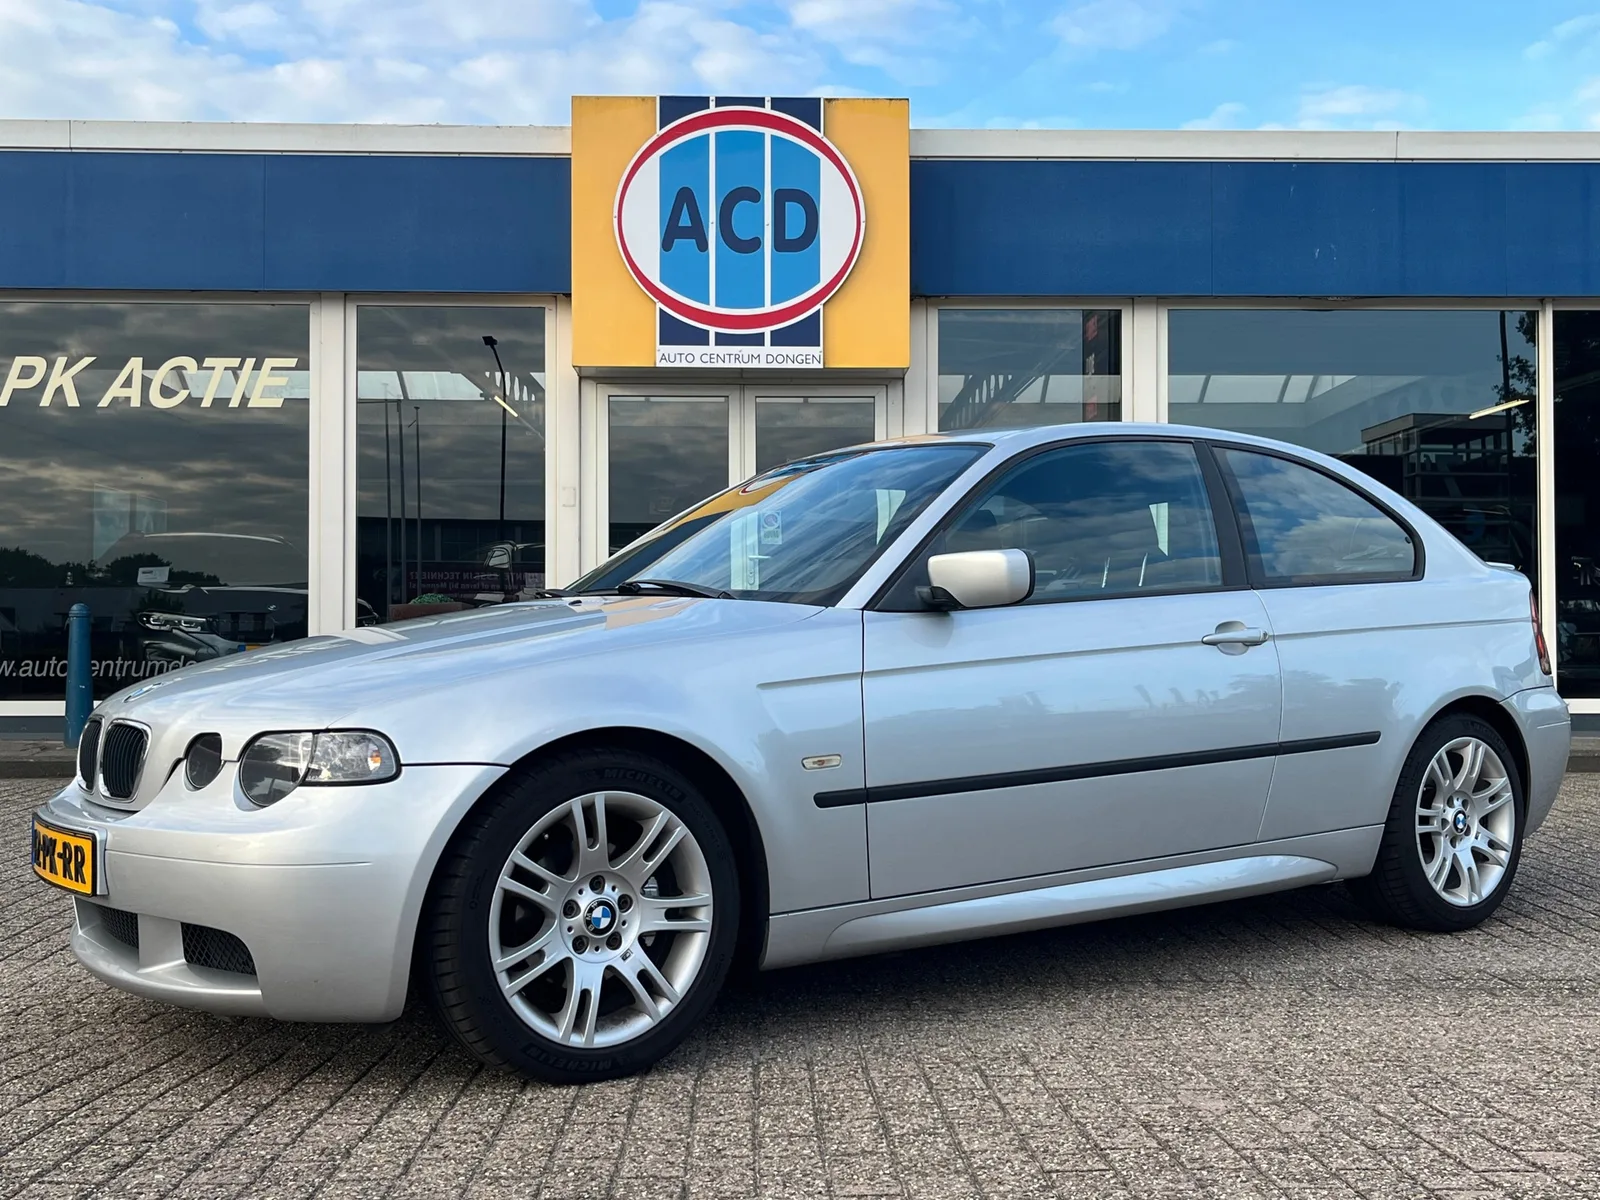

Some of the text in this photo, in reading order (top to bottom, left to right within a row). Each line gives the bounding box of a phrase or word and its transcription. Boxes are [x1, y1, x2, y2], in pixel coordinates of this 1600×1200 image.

[661, 186, 819, 254] ACD
[0, 355, 299, 409] PK ACTIE
[659, 353, 822, 365] AUTO CENTRUM DONGEN
